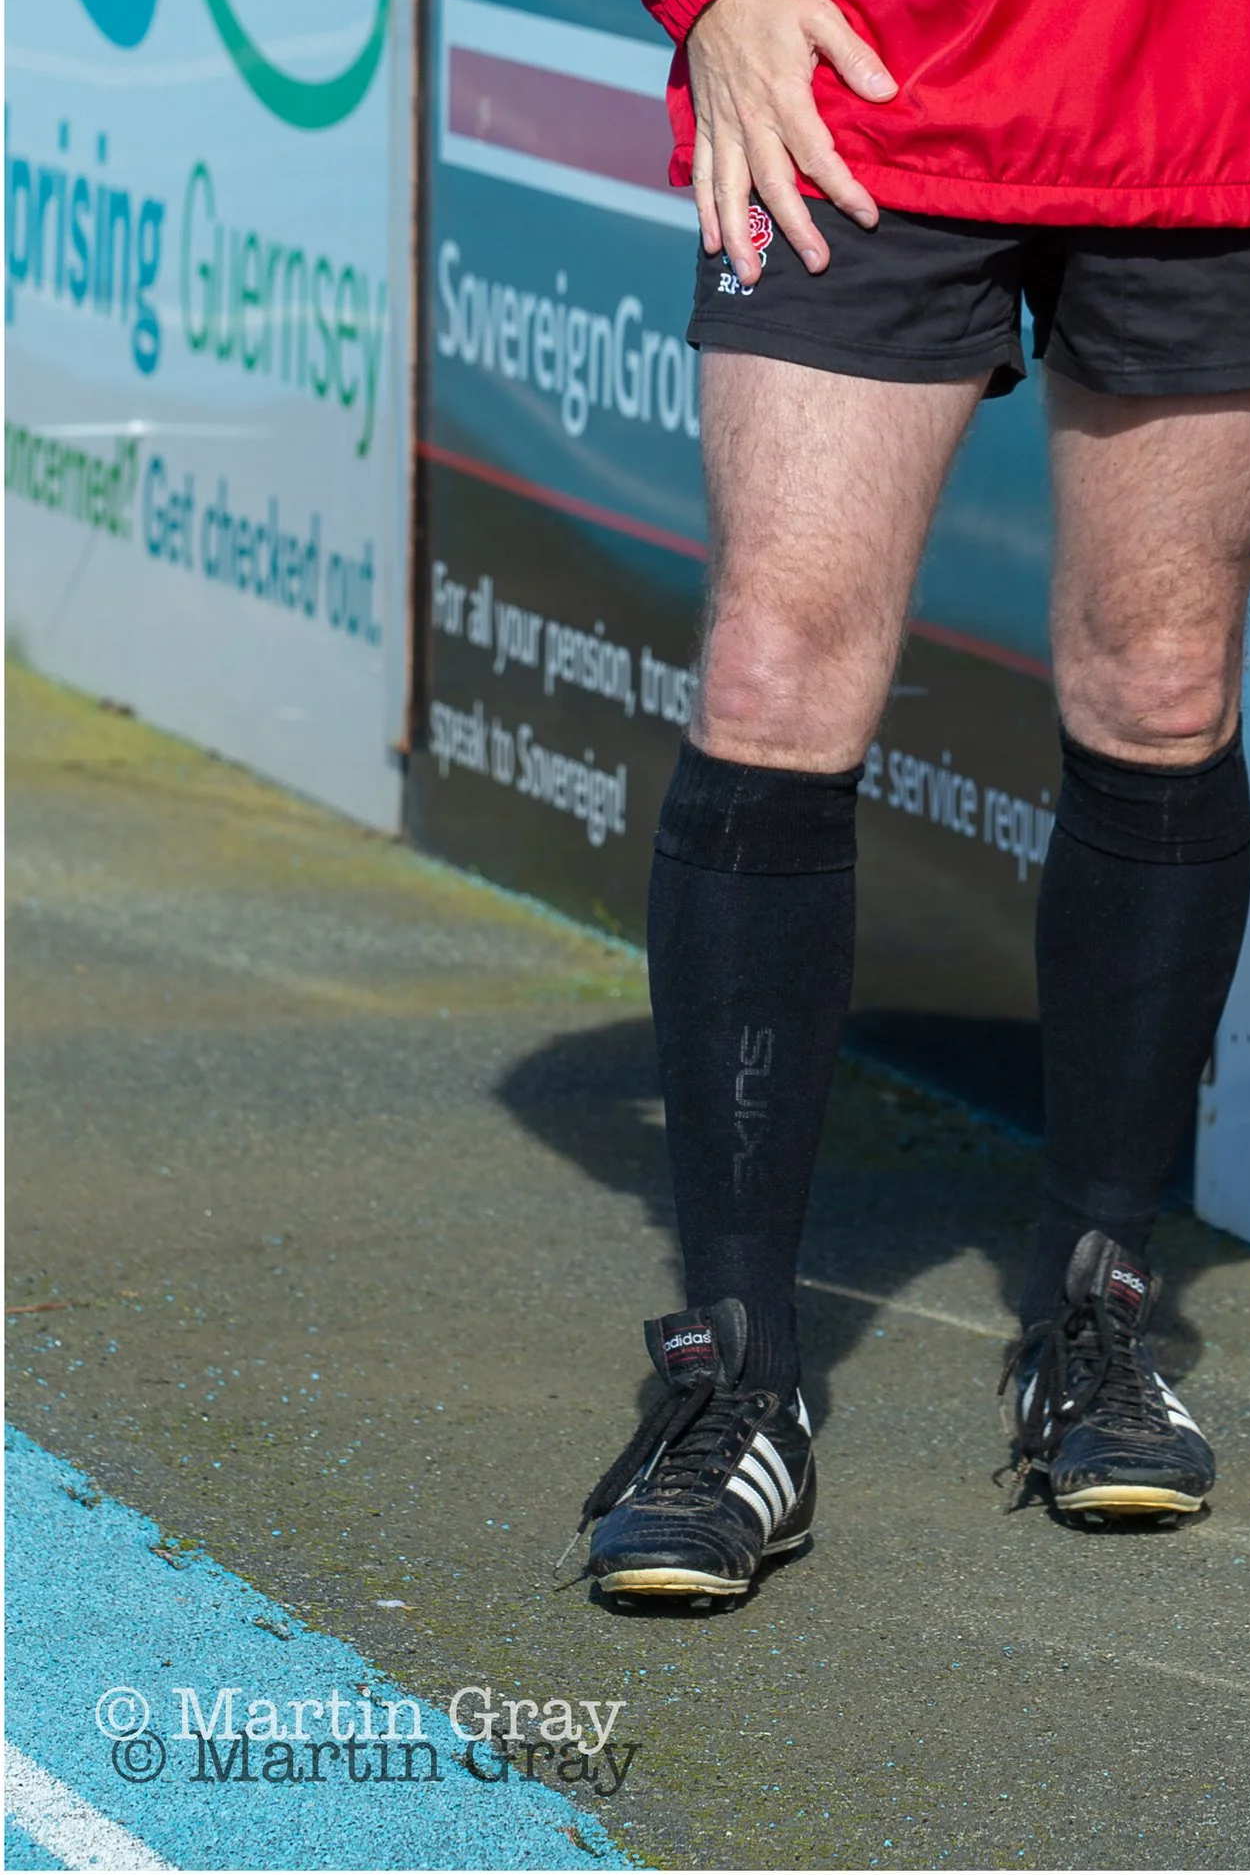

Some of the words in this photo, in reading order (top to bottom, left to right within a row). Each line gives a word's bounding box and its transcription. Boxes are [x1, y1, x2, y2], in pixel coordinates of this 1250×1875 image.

[4, 101, 165, 377] prising
[180, 159, 388, 459] Guernsey
[437, 237, 699, 441] SovereignGrou
[142, 453, 195, 572] Get
[202, 475, 321, 621] checked
[325, 537, 383, 649] out.
[429, 698, 489, 780] speak
[489, 717, 516, 787] to
[515, 722, 629, 848] Sovereign!
[431, 559, 467, 637] For
[467, 573, 494, 650] all
[494, 598, 544, 677] your
[543, 618, 637, 718] pension,
[640, 645, 699, 727] trus
[887, 748, 979, 839] service
[982, 786, 1057, 883] requi
[663, 1329, 713, 1352] adidas
